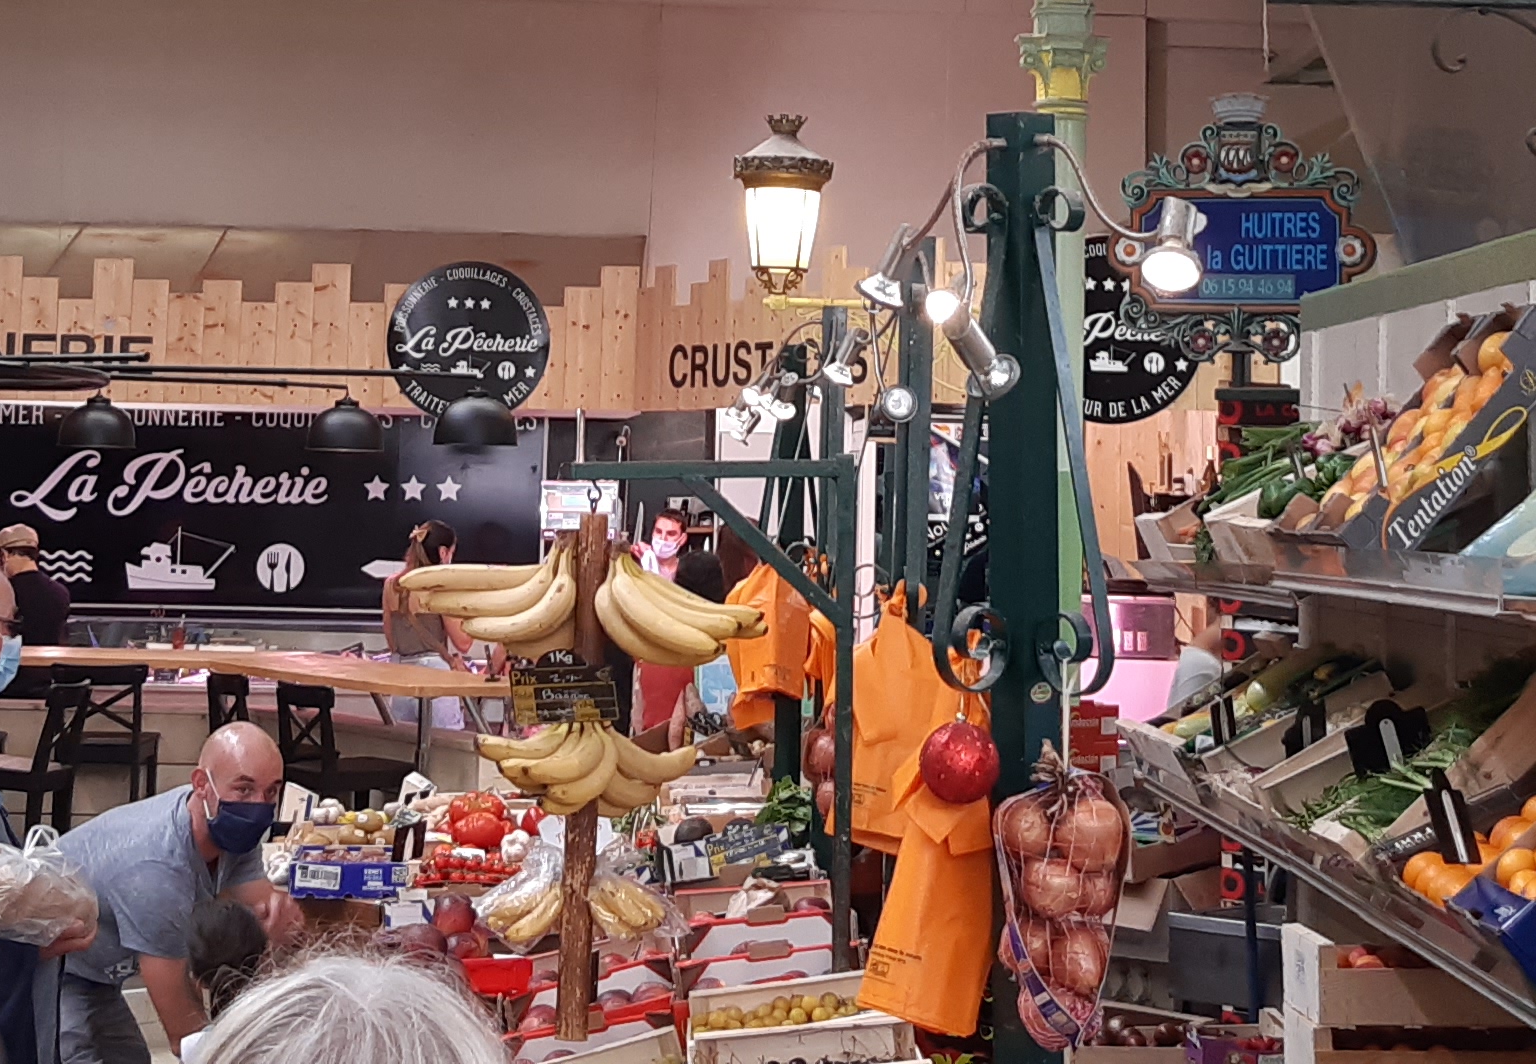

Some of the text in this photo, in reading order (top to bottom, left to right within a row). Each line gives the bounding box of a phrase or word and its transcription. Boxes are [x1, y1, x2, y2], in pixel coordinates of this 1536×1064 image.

[1241, 211, 1320, 238] HUITRES
[1207, 244, 1328, 270] la GUITTIERE
[446, 267, 508, 288] COQUILLAGES
[1202, 277, 1293, 295] 06 15 94 46 94
[395, 325, 540, 359] La Pêcherie
[669, 340, 868, 388] CRUSTS
[502, 381, 530, 407] MER
[1109, 401, 1127, 418] DE
[1133, 397, 1151, 414] LA
[1153, 375, 1182, 405] MER
[10, 448, 329, 522] La Pêcherie
[511, 671, 538, 685] Prix
